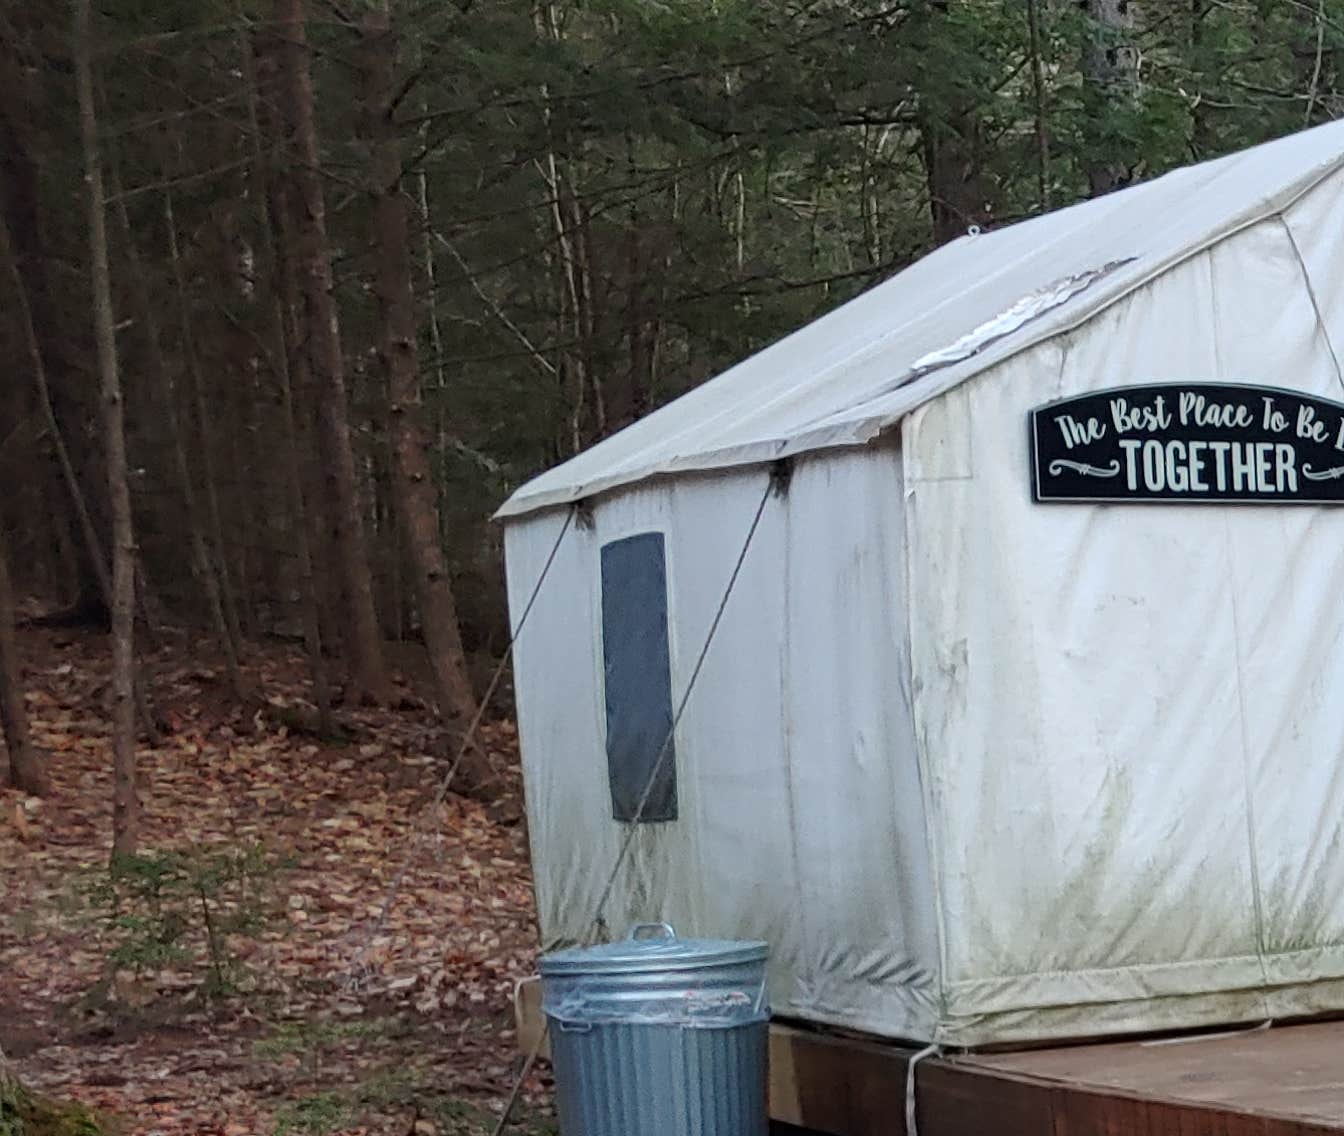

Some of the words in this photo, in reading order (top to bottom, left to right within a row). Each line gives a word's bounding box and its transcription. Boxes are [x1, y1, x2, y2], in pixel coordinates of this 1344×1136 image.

[1054, 414, 1106, 449] The
[1110, 396, 1171, 433] Best
[1179, 391, 1253, 428] Place
[1262, 397, 1289, 433] To
[1296, 405, 1329, 443] Be
[1119, 439, 1298, 492] TOGETHER
